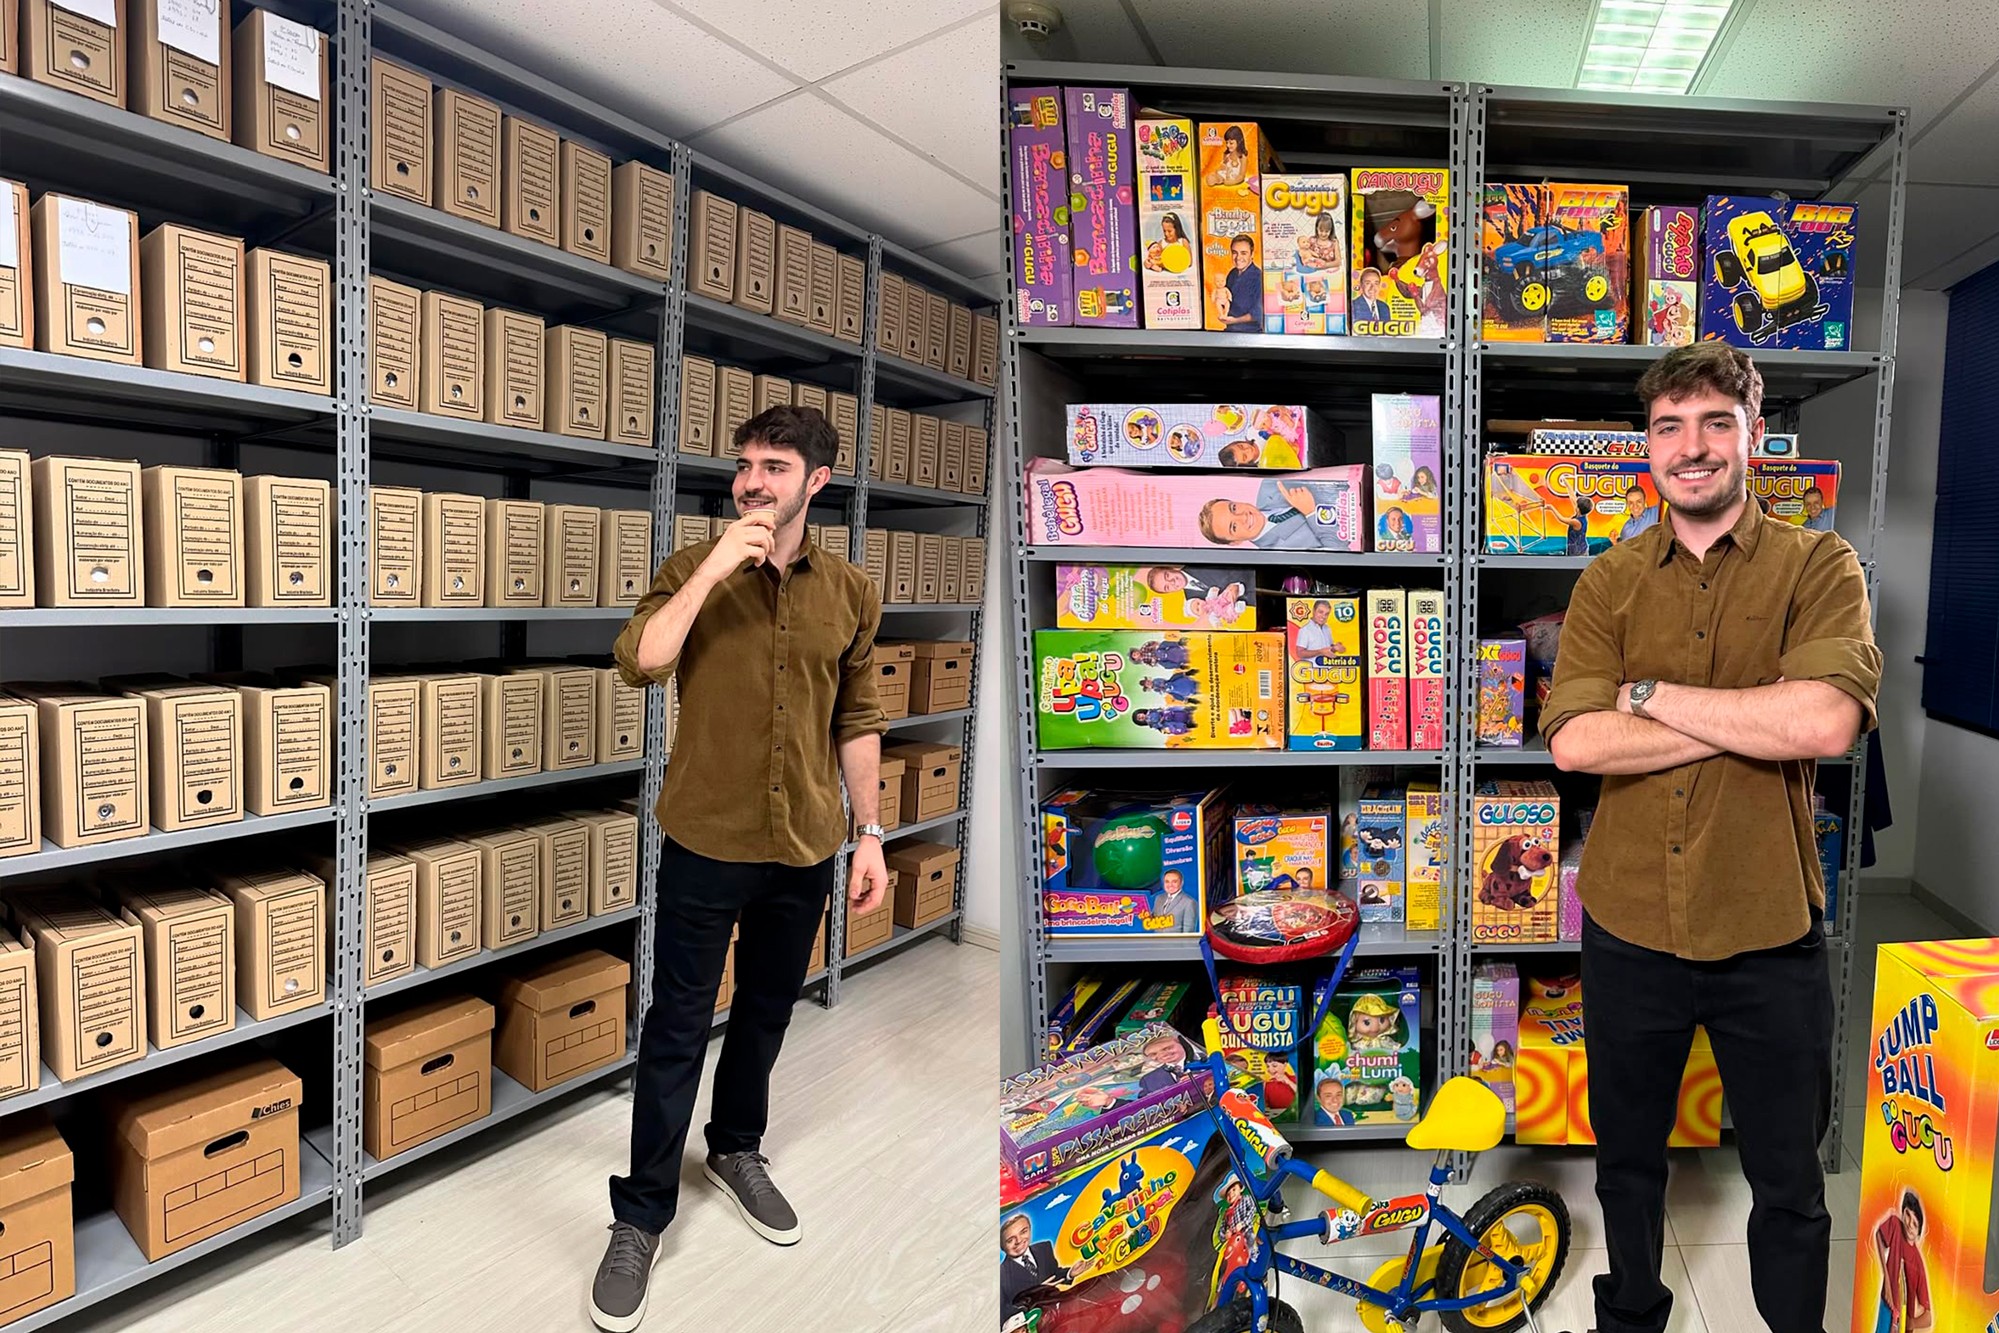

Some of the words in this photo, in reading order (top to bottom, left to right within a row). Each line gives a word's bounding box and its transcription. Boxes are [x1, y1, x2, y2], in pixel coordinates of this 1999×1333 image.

[1108, 134, 1118, 173] GUGU
[1109, 174, 1116, 186] do
[1358, 171, 1443, 194] CANGUGU
[1086, 132, 1108, 275] Bancadinha
[1265, 182, 1339, 215] Gugu
[1559, 191, 1620, 207] BIG
[1032, 143, 1056, 286] Bancadinha
[1555, 206, 1614, 217] FOOT
[1792, 204, 1855, 223] BIG
[1208, 213, 1256, 238] Legal
[1788, 221, 1847, 232] FOOT
[1025, 233, 1032, 244] do
[1207, 246, 1230, 257] Gugu
[1665, 242, 1674, 271] GUGU
[1024, 245, 1035, 284] GUGU
[1157, 307, 1191, 316] Cotiplás
[1353, 321, 1416, 336] GUGU
[1085, 416, 1098, 452] GUGU
[1584, 462, 1610, 471] Basquete
[1611, 462, 1619, 470] do
[1762, 463, 1787, 473] Basquete
[1789, 464, 1797, 472] do
[1037, 479, 1055, 510] legal
[1051, 481, 1083, 535] GUGU
[1338, 491, 1348, 540] Cotiplás
[1042, 511, 1059, 541] Bebê
[1101, 577, 1109, 600] Gugu
[1101, 602, 1109, 614] do
[1296, 606, 1304, 616] G
[1336, 607, 1353, 618] 10
[1374, 616, 1387, 674] GOMA
[1388, 616, 1401, 674] GUGU
[1414, 617, 1427, 675] GOMA
[1428, 617, 1441, 674] GUGU
[1291, 660, 1357, 684] GUGU
[1323, 656, 1347, 666] Bateria
[1348, 656, 1356, 666] do
[1040, 657, 1053, 712] Cavalinho
[1053, 659, 1081, 712] Upa
[1075, 653, 1102, 720] Upa!
[1100, 653, 1128, 712] GUGU
[1479, 803, 1556, 826] GULOSO
[1163, 857, 1193, 867] Manobras
[1165, 845, 1194, 854] Diversão
[1061, 917, 1102, 927] brincadeira
[1103, 914, 1133, 926] legal!
[1142, 914, 1174, 931] GUGU
[1474, 924, 1521, 939] GUGU
[1217, 1012, 1291, 1033] GUGU
[1875, 994, 1938, 1068] JUMP
[1065, 1022, 1167, 1069] REPASSA
[1346, 1052, 1398, 1067] chumi
[1362, 1064, 1402, 1078] Lumi
[1882, 1054, 1945, 1113] BALL
[262, 1099, 291, 1115] Chies
[1058, 1124, 1115, 1162] PASSA
[1118, 1090, 1193, 1136] REPASSA
[1235, 1117, 1268, 1158] GUGU
[1882, 1100, 1898, 1125] DO
[1891, 1109, 1953, 1171] GUGU
[1076, 1153, 1091, 1163] UMA
[1092, 1146, 1109, 1157] NOVA
[1111, 1133, 1136, 1148] RODADA
[1138, 1128, 1145, 1136] DE
[1146, 1115, 1176, 1132] EMOÇÕES!
[1024, 1152, 1047, 1173] TV
[1024, 1167, 1048, 1181] GAME
[1071, 1171, 1177, 1247] Cavalinho
[1372, 1205, 1424, 1230] GUGU
[1080, 1221, 1124, 1260] Upa
[1114, 1216, 1160, 1264] GUGU
